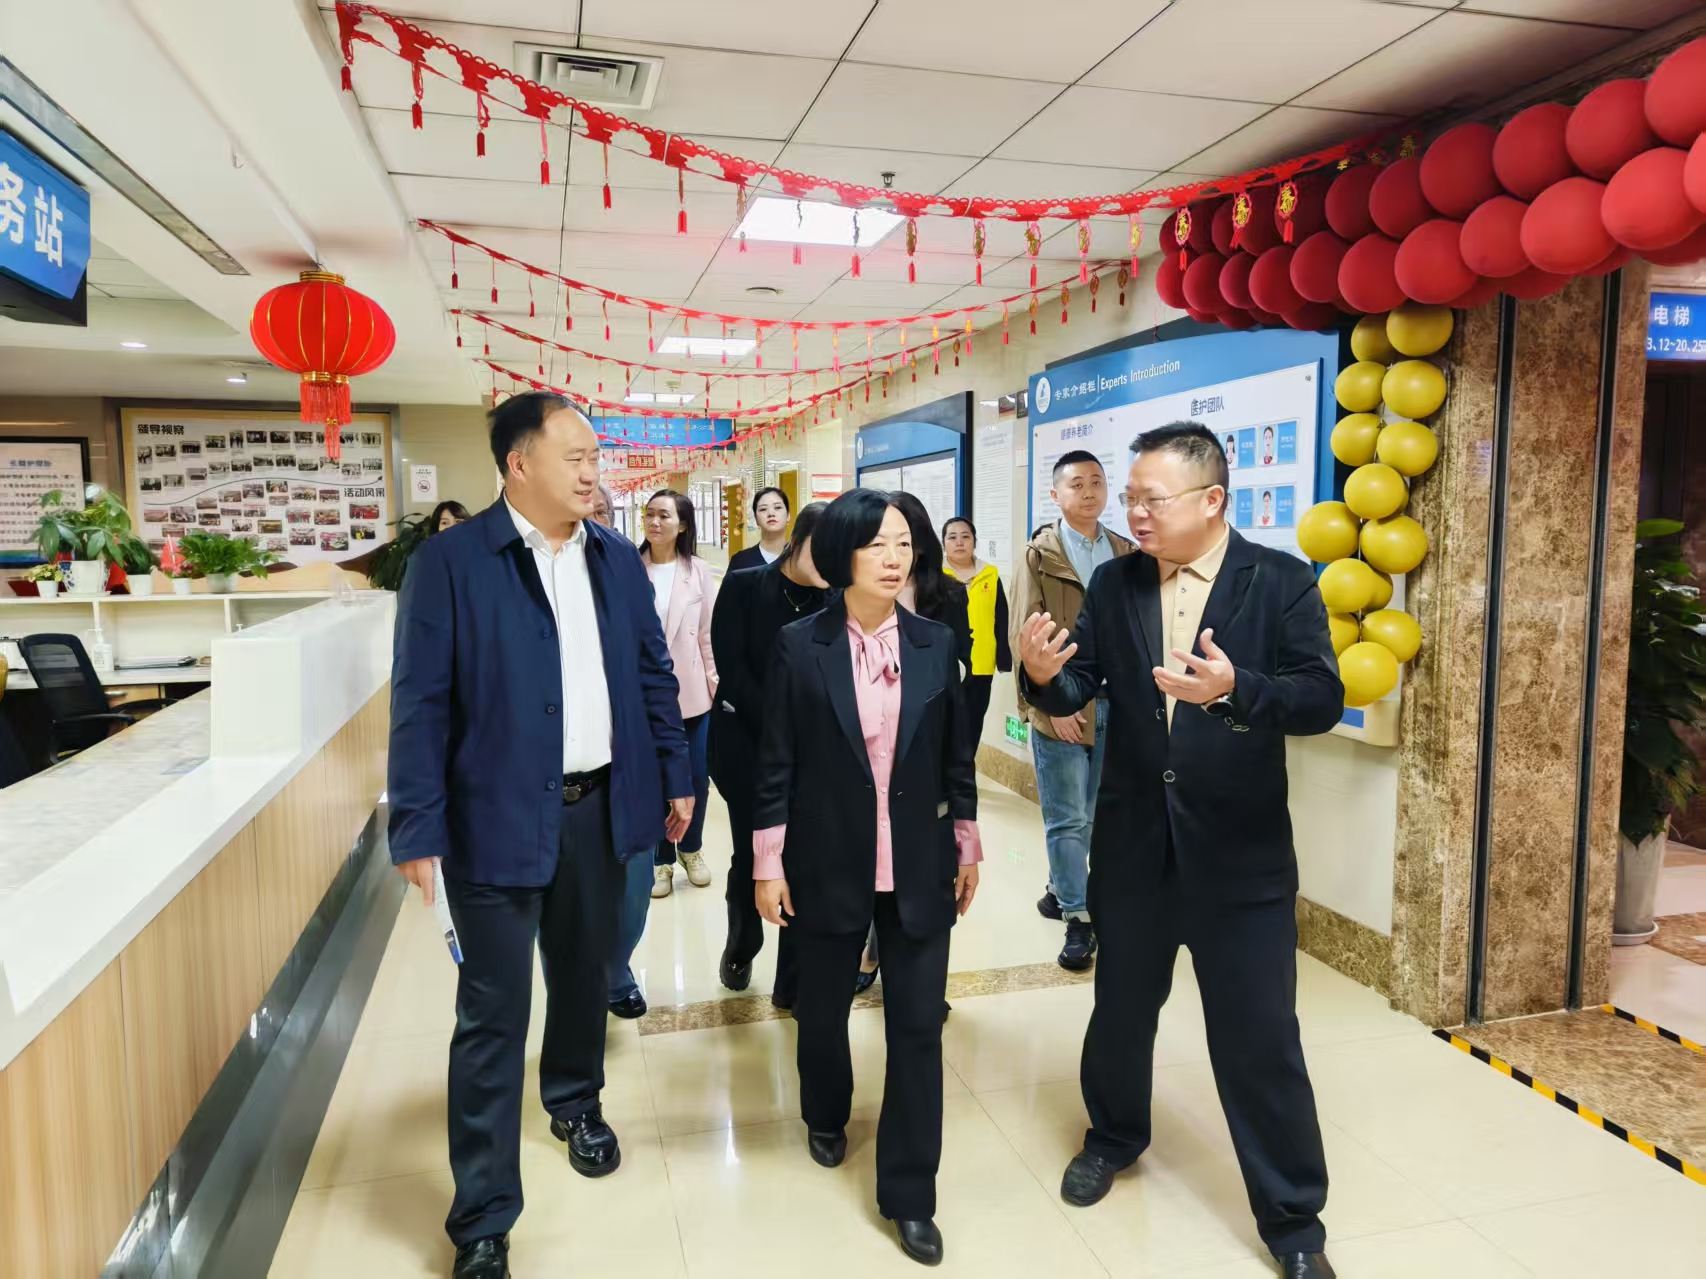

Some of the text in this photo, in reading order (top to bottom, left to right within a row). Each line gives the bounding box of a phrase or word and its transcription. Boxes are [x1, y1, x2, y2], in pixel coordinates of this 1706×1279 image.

[1654, 304, 1690, 327] 电梯
[1100, 360, 1180, 391] Experts Introduction
[1055, 379, 1096, 400] 专家介绍栏
[1191, 395, 1225, 417] 医护团队
